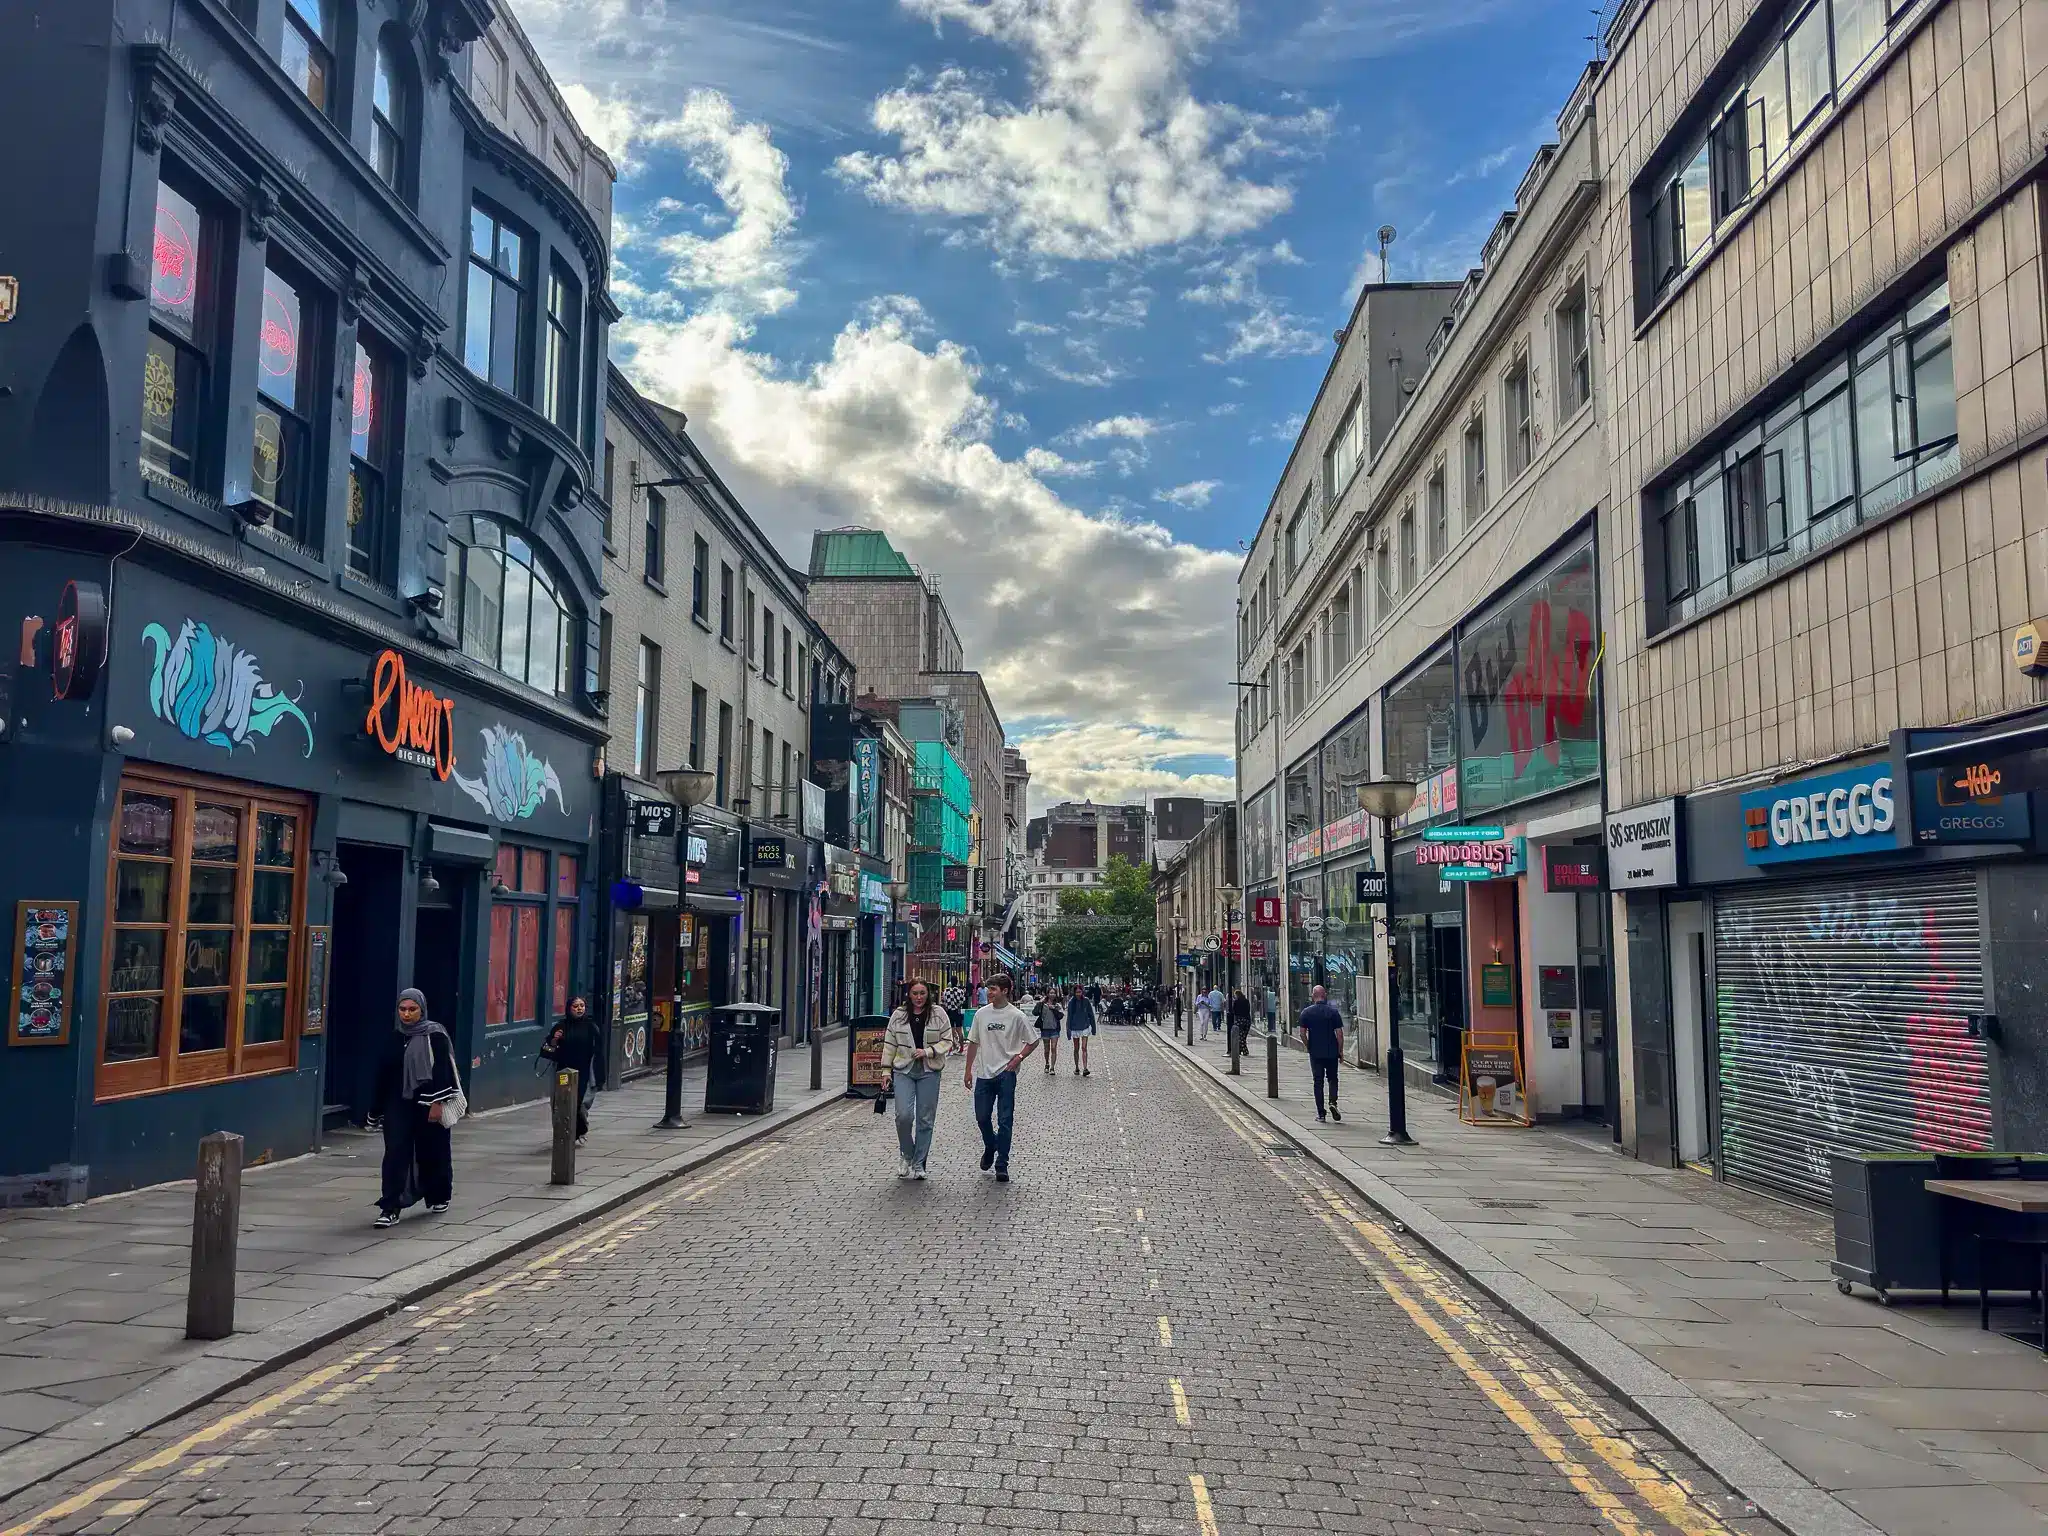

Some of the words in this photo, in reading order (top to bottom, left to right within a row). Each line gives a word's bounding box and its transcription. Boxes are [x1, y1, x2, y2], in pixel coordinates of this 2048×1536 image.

[2018, 639, 2033, 652] ADT
[398, 749, 413, 761] BIG
[416, 755, 436, 767] EARS
[640, 805, 672, 818] MO'S
[1771, 777, 1895, 846] GREGGS
[1624, 816, 1671, 843] SEVENSTAY
[1940, 816, 2005, 830] GREGGS
[1416, 844, 1514, 865] BUNDOBUST
[1580, 864, 1589, 872] ST
[976, 869, 984, 891] latino
